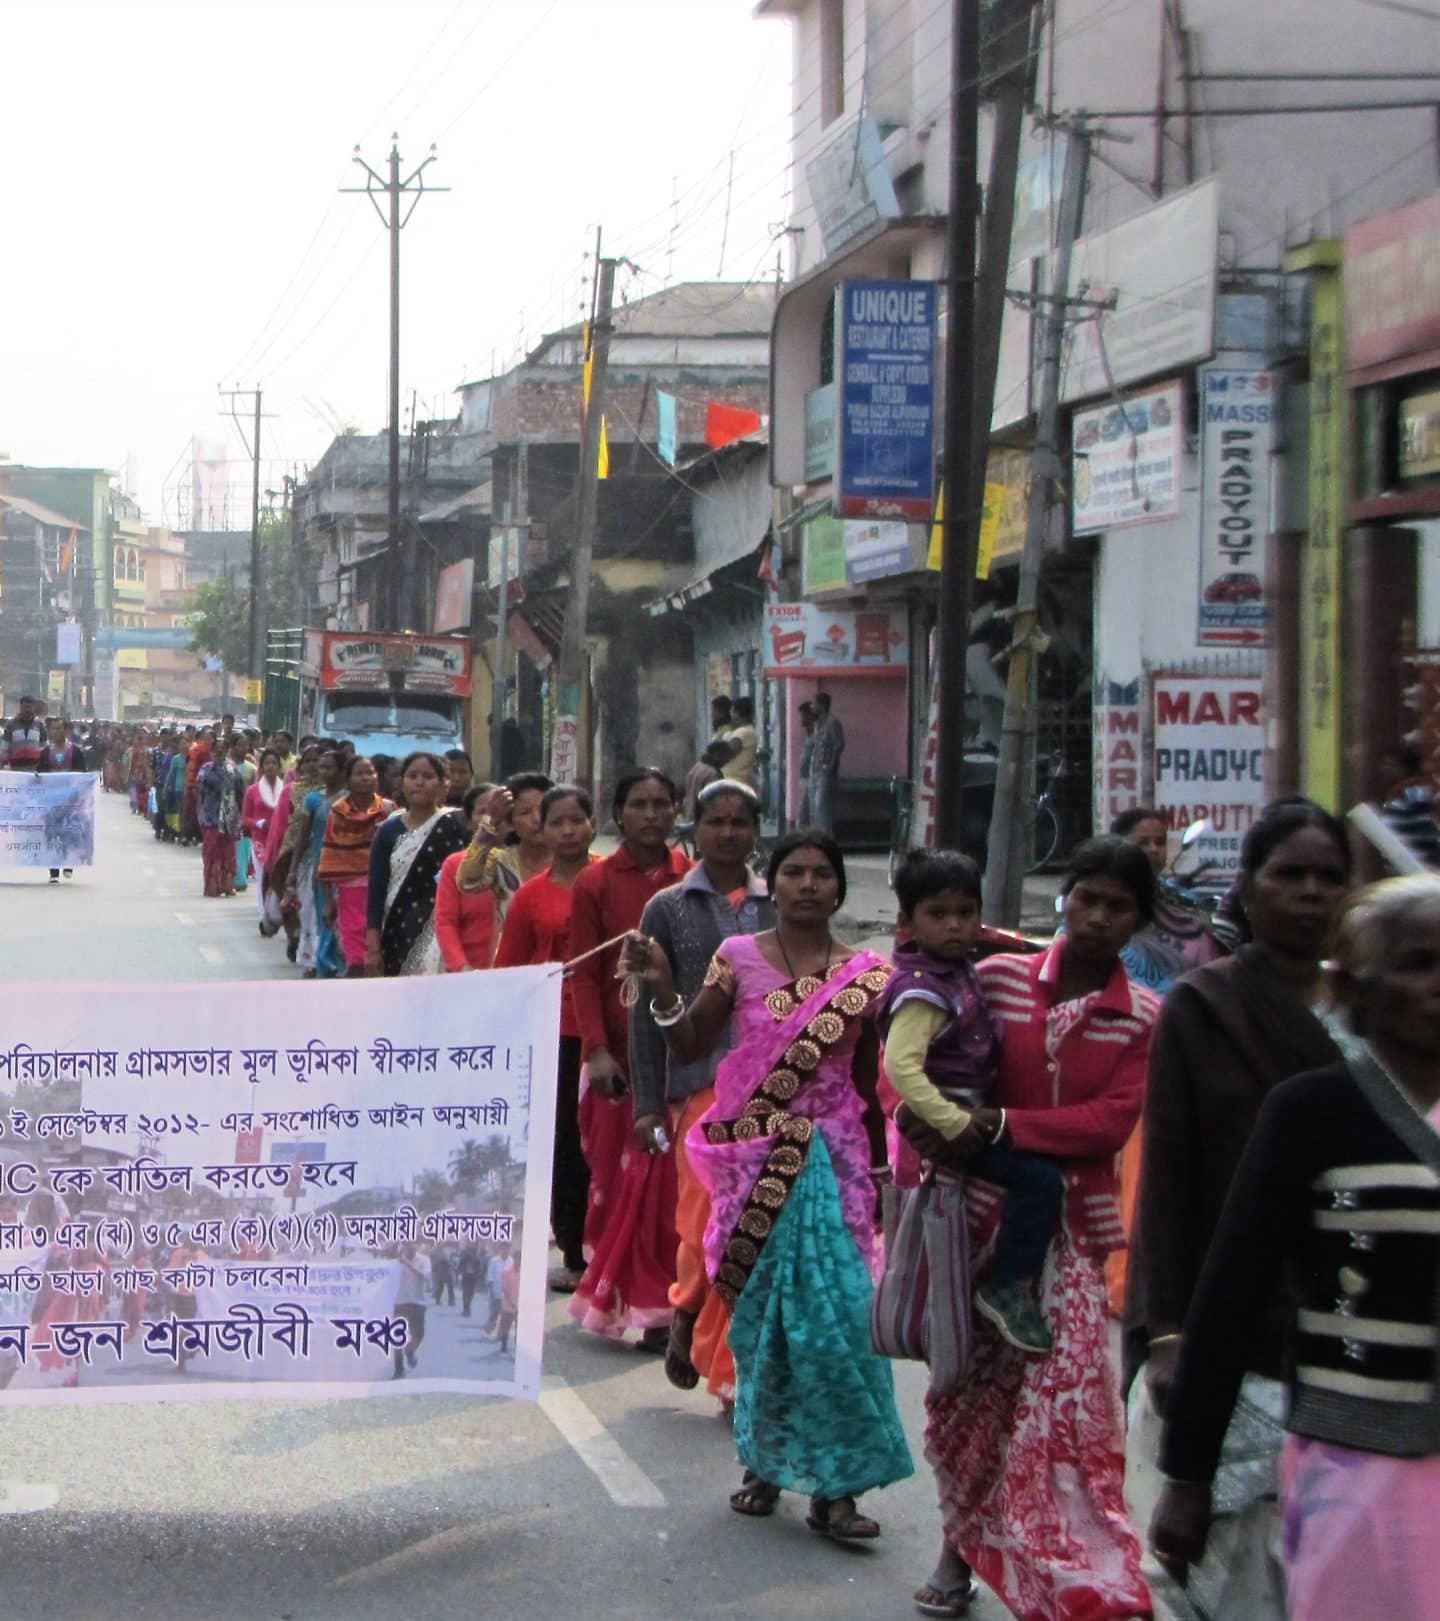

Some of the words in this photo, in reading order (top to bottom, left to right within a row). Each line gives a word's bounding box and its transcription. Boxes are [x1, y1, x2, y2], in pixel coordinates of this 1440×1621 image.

[852, 290, 926, 323] UNIQUE
[1207, 404, 1270, 423] MASS
[767, 606, 802, 617] EXIDE
[125, 1048, 232, 1079] গ্রামসভার
[240, 1048, 278, 1083] মূল
[287, 1038, 358, 1082] ভূমিকা
[368, 1038, 439, 1074] স্বীকার
[448, 1044, 496, 1071] করে
[12, 1109, 28, 1137] ই
[221, 1113, 253, 1132] এর
[262, 1102, 360, 1132] সংশোধিত
[368, 1102, 424, 1128] আইন
[50, 1168, 92, 1194] কে
[102, 1158, 194, 1194] বাতিল
[202, 1162, 292, 1190] করতে
[300, 1160, 358, 1188] হবে
[56, 1224, 89, 1249] এর
[144, 1224, 158, 1244] ও
[167, 1222, 182, 1246] ৫
[191, 1220, 222, 1245] এর
[423, 1212, 512, 1242] গ্রামসভার
[114, 1271, 155, 1292] গাছ
[164, 1264, 214, 1289] কাটা
[224, 1264, 308, 1288] চলবেনা
[142, 1302, 314, 1362] শ্রমজীবী
[330, 1315, 408, 1357] মঞ্চ
